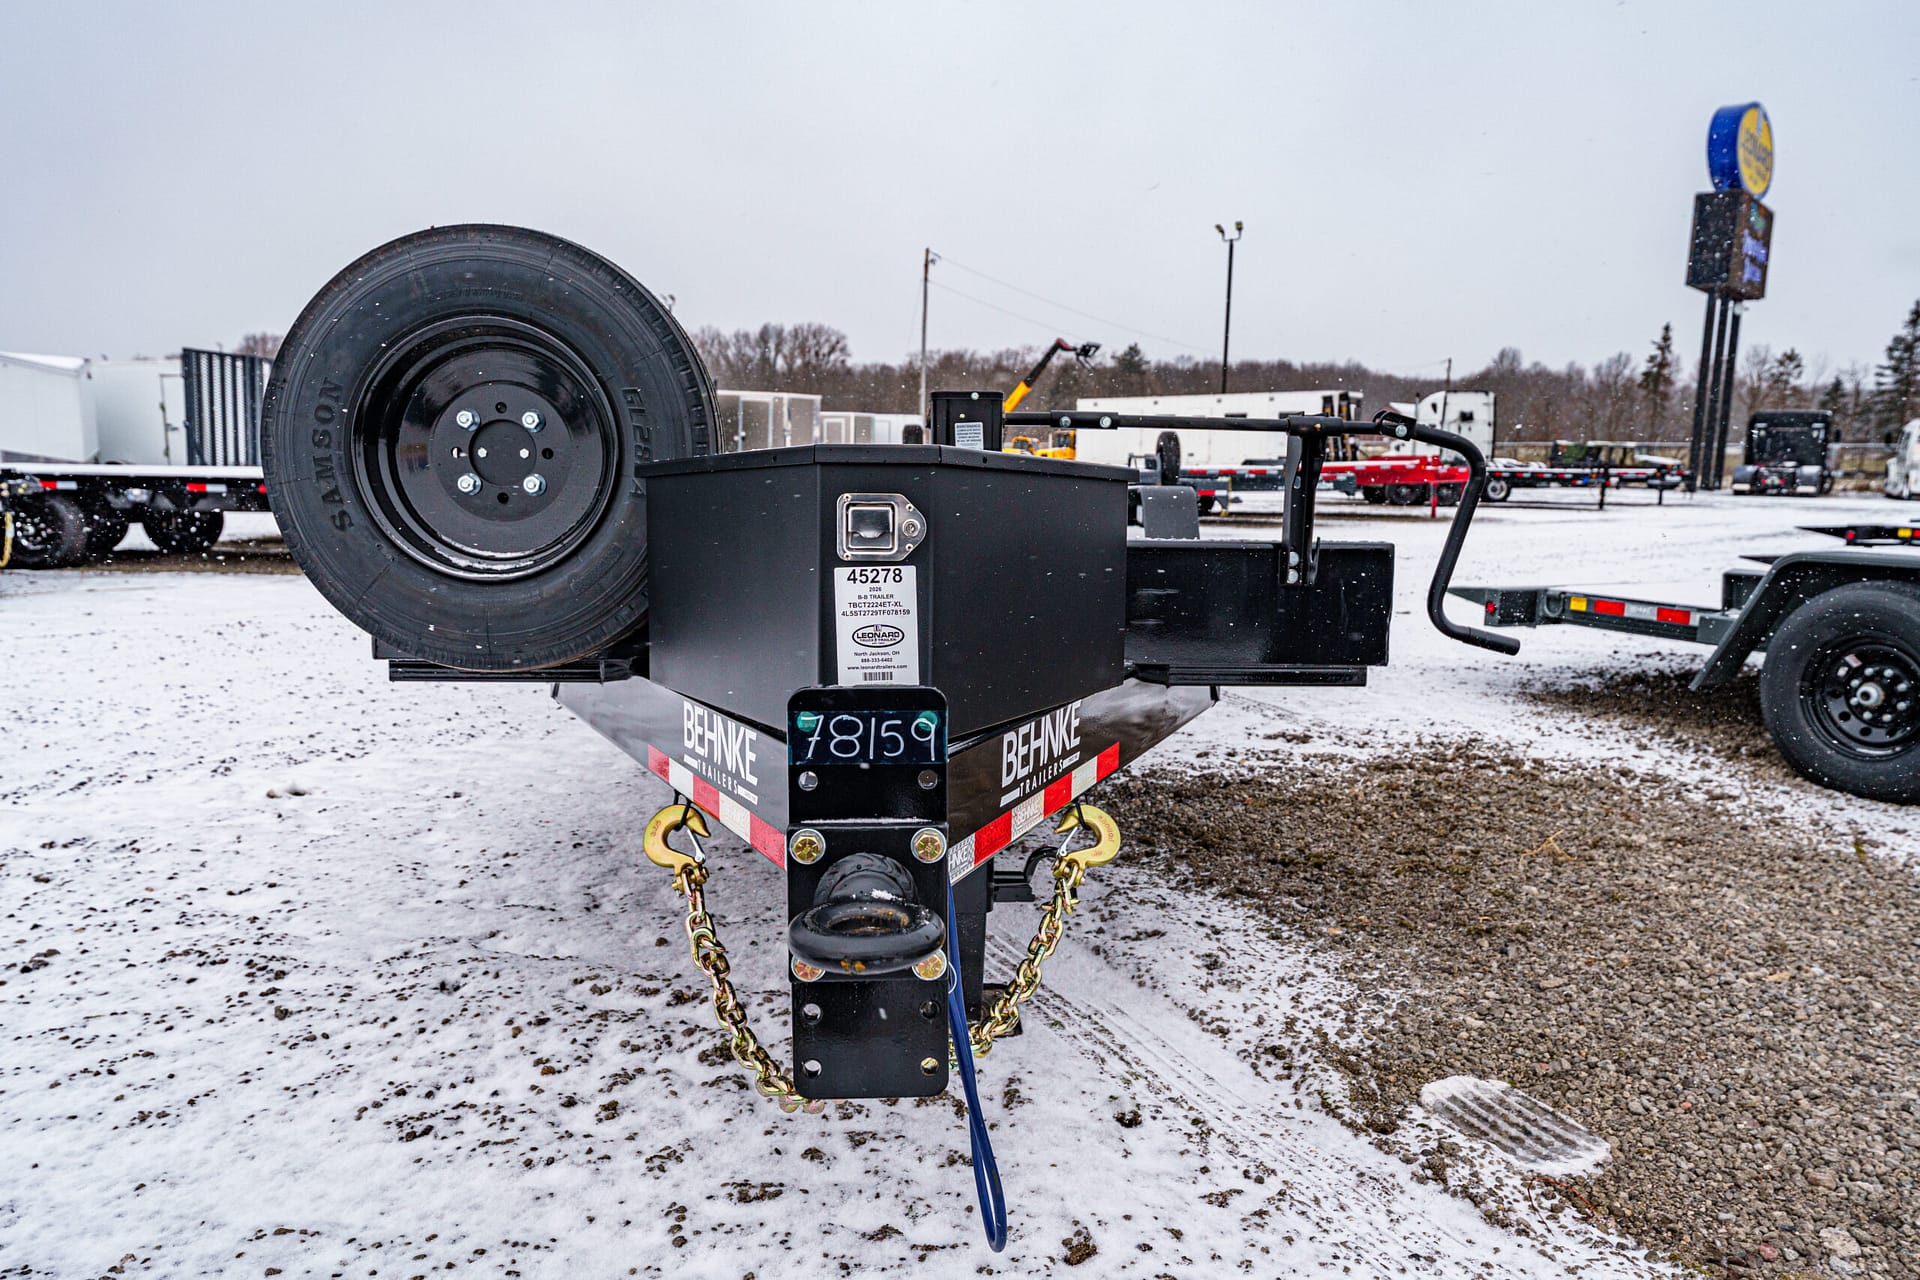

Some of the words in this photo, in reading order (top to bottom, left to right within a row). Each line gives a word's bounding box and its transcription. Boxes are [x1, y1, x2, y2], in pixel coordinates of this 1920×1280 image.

[312, 377, 354, 531] SAMSON
[847, 568, 903, 584] 45278
[683, 700, 758, 787] BEHNKE
[800, 714, 936, 761] 78159
[1002, 700, 1081, 788] BEHNKE
[697, 760, 738, 794] TRAILERS
[1019, 759, 1064, 796] TRAILERS
